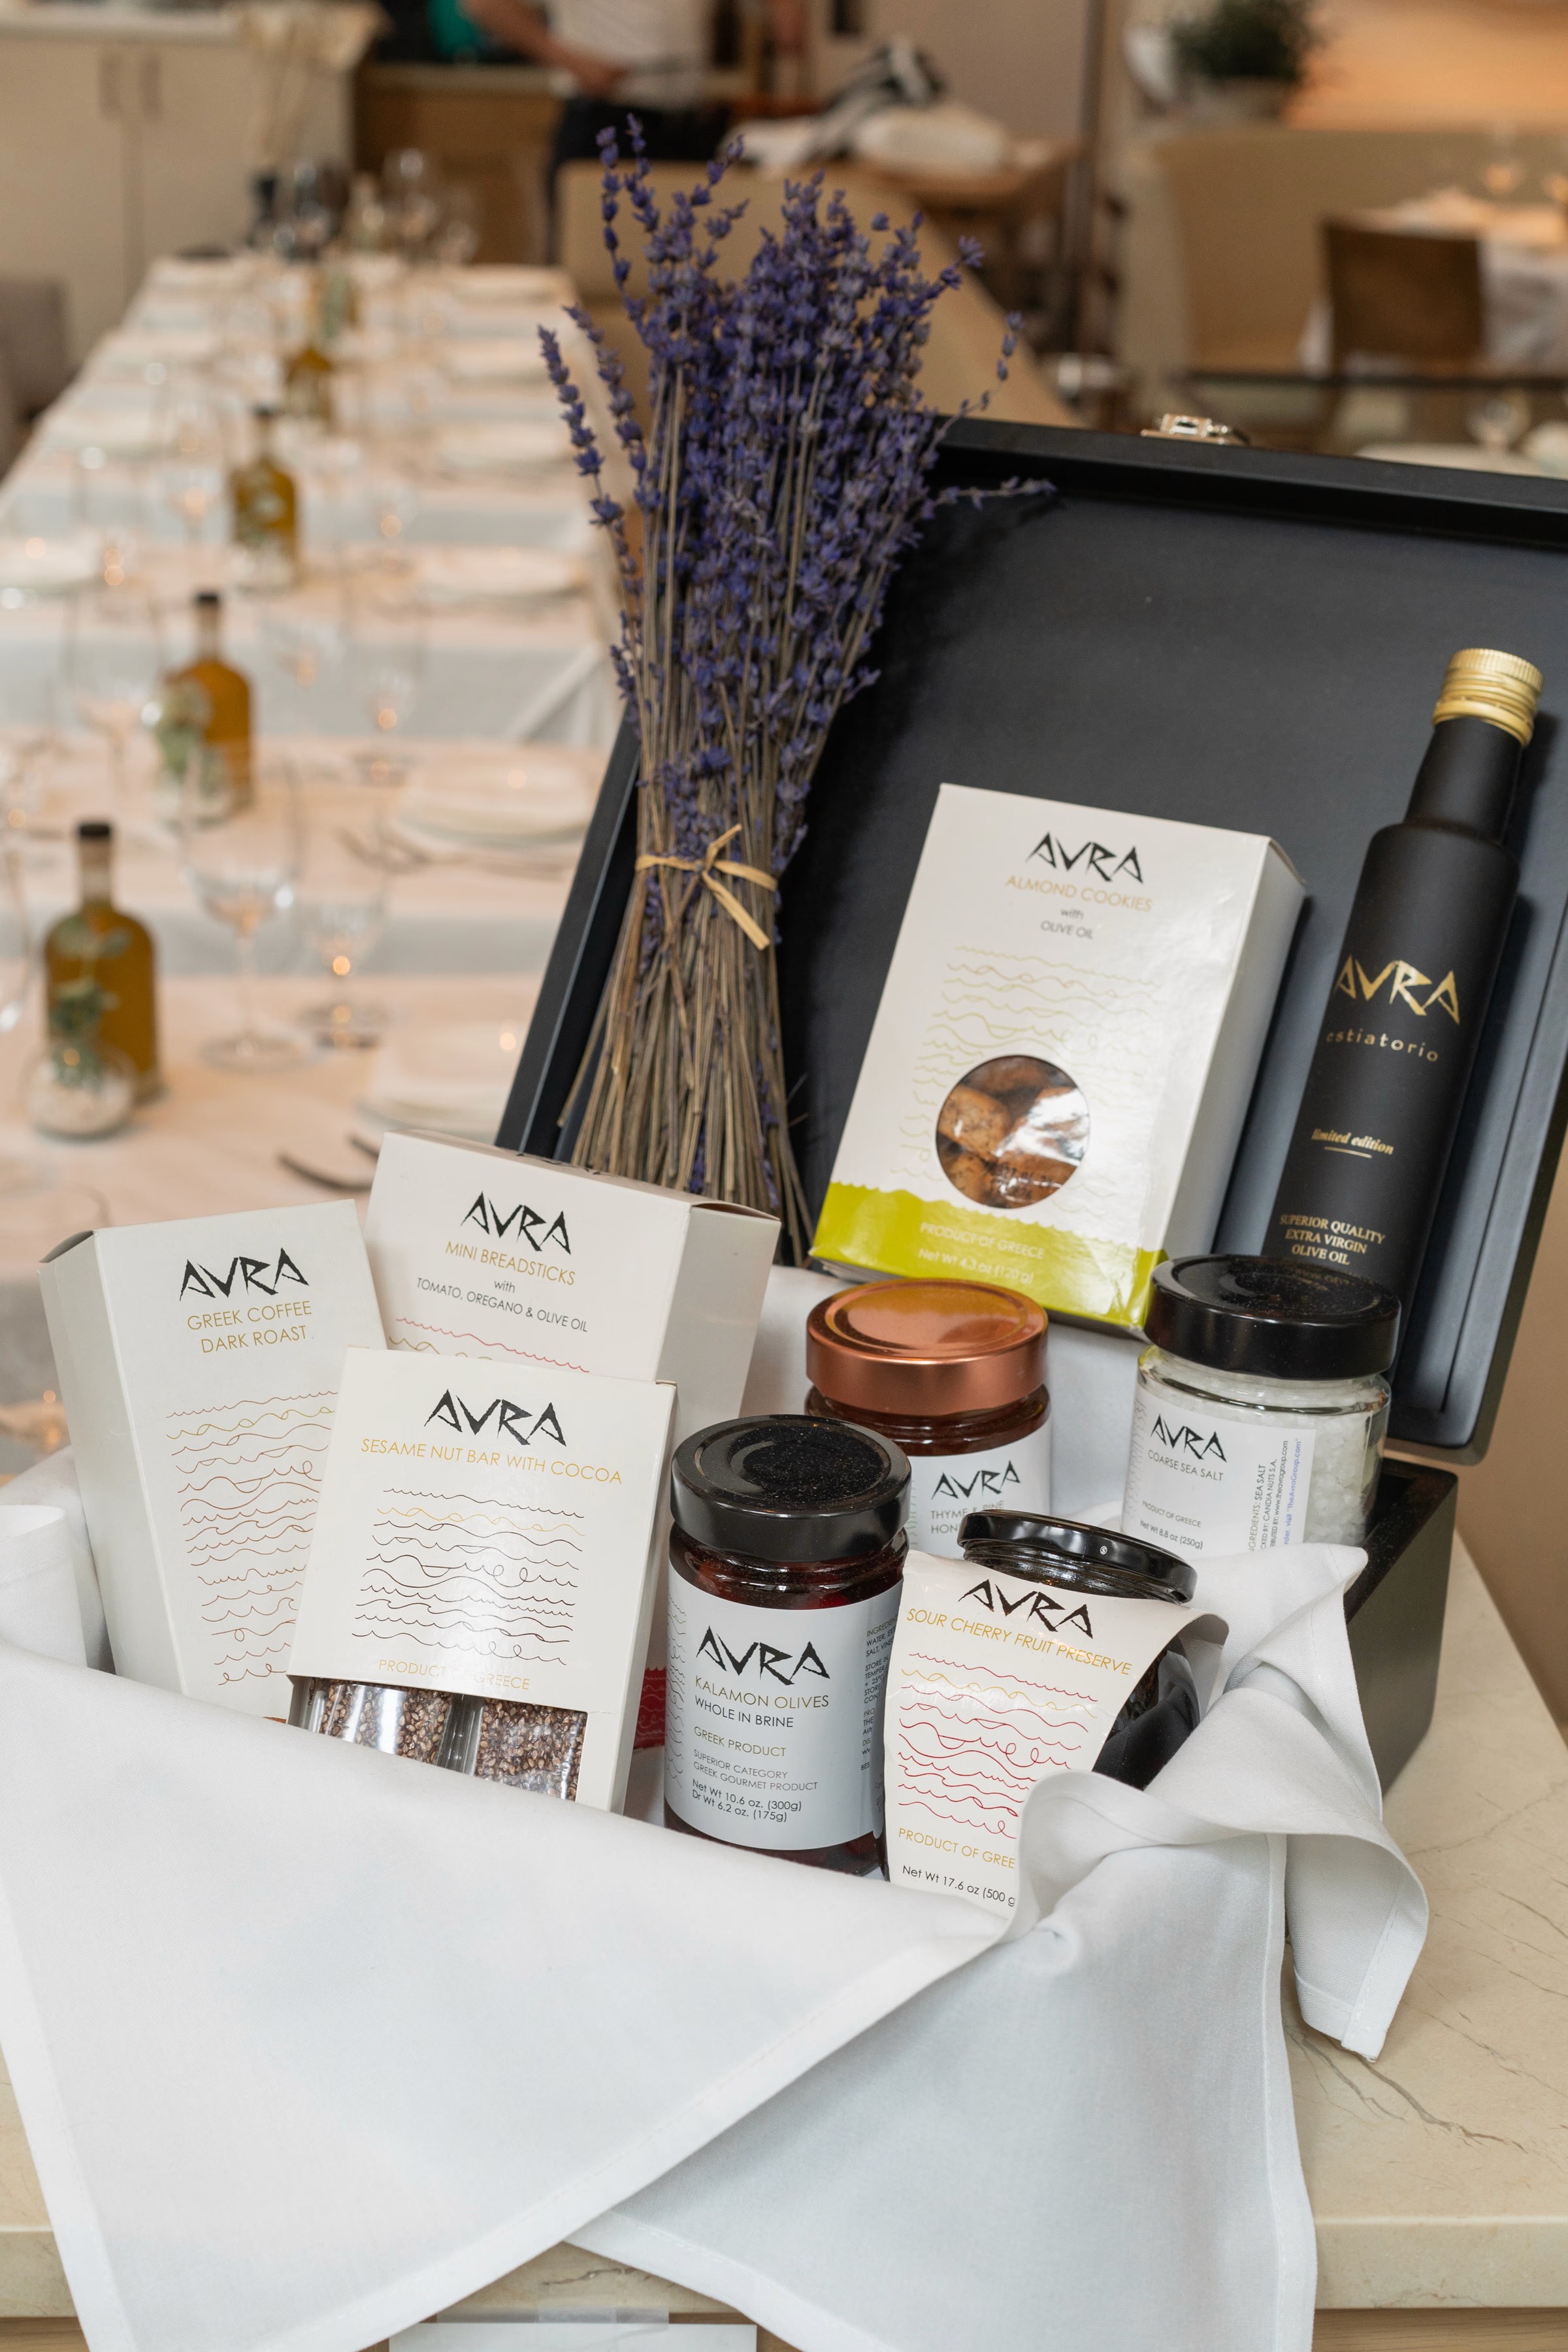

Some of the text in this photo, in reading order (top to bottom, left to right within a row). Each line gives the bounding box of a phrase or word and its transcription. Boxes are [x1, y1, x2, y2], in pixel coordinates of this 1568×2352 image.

[1026, 832, 1143, 885] AVRA
[1005, 875, 1152, 912] ALMOND COOKIES
[1060, 907, 1084, 919] with
[1041, 921, 1094, 939] OLIVE OIL
[1332, 953, 1461, 1026] AVRA
[1326, 1028, 1439, 1062] estiatorio
[1311, 1128, 1394, 1154] limited edition
[461, 1191, 571, 1255] AVRA
[1280, 1213, 1386, 1244] SUPERIOR QUALITY
[918, 1249, 940, 1262] Net
[919, 1222, 1045, 1259] PRODUCT OF GREECE
[1284, 1228, 1367, 1254] EXTRA VIRGIN
[1292, 1244, 1350, 1266] OLIVE OIL
[180, 1248, 309, 1301] AVRA
[445, 1241, 576, 1286] MINI BREADSTICKS
[493, 1279, 515, 1294] with
[187, 1301, 312, 1330] GREEK COFFEE
[416, 1277, 588, 1333] TOMATO, OREGANO & OLIVE OIL
[201, 1325, 307, 1354] DARK ROAST
[424, 1389, 566, 1446] AVRA
[1150, 1413, 1227, 1463] AVRA
[361, 1439, 622, 1484] SESAME NUT BAR WITH COCOA
[1148, 1450, 1224, 1481] COARSE SEA SALT
[1257, 1465, 1266, 1483] SALT
[932, 1460, 1021, 1499] AVRA
[1254, 1486, 1264, 1501] SEA
[1142, 1500, 1165, 1516] PRODUCT
[1175, 1515, 1201, 1527] GREECE
[1263, 1492, 1273, 1521] CANDIA
[931, 1524, 960, 1534] HON
[1180, 1535, 1203, 1550] (250g)
[958, 1578, 1094, 1639] AVRA
[696, 1625, 830, 1686] AVRA
[907, 1608, 1133, 1675] SOUR CHERRY FRUIT PRESERVE
[379, 1659, 446, 1677] PRODUCT
[473, 1672, 531, 1690] GREECE
[865, 1658, 882, 1671] STORE
[695, 1676, 829, 1709] KALAMON OLIVES
[695, 1695, 794, 1727] WHOLE IN BRINE
[694, 1726, 787, 1756] GREEK PRODUCT
[694, 1749, 788, 1779] SUPERIOR CATEGORY
[694, 1761, 818, 1791] GREEK GOURMET PRODUCT
[693, 1779, 802, 1812] Net Wt 10.6 oz. (300g)
[693, 1789, 787, 1823] Dr Wt 6.2 oz. (175g)
[899, 1827, 1015, 1869] PRODUCT OF GREE
[902, 1865, 922, 1878] Net
[925, 1871, 939, 1883] Wt
[943, 1876, 964, 1890] 17.6
[967, 1886, 979, 1895] oz
[983, 1887, 1005, 1902] (500
